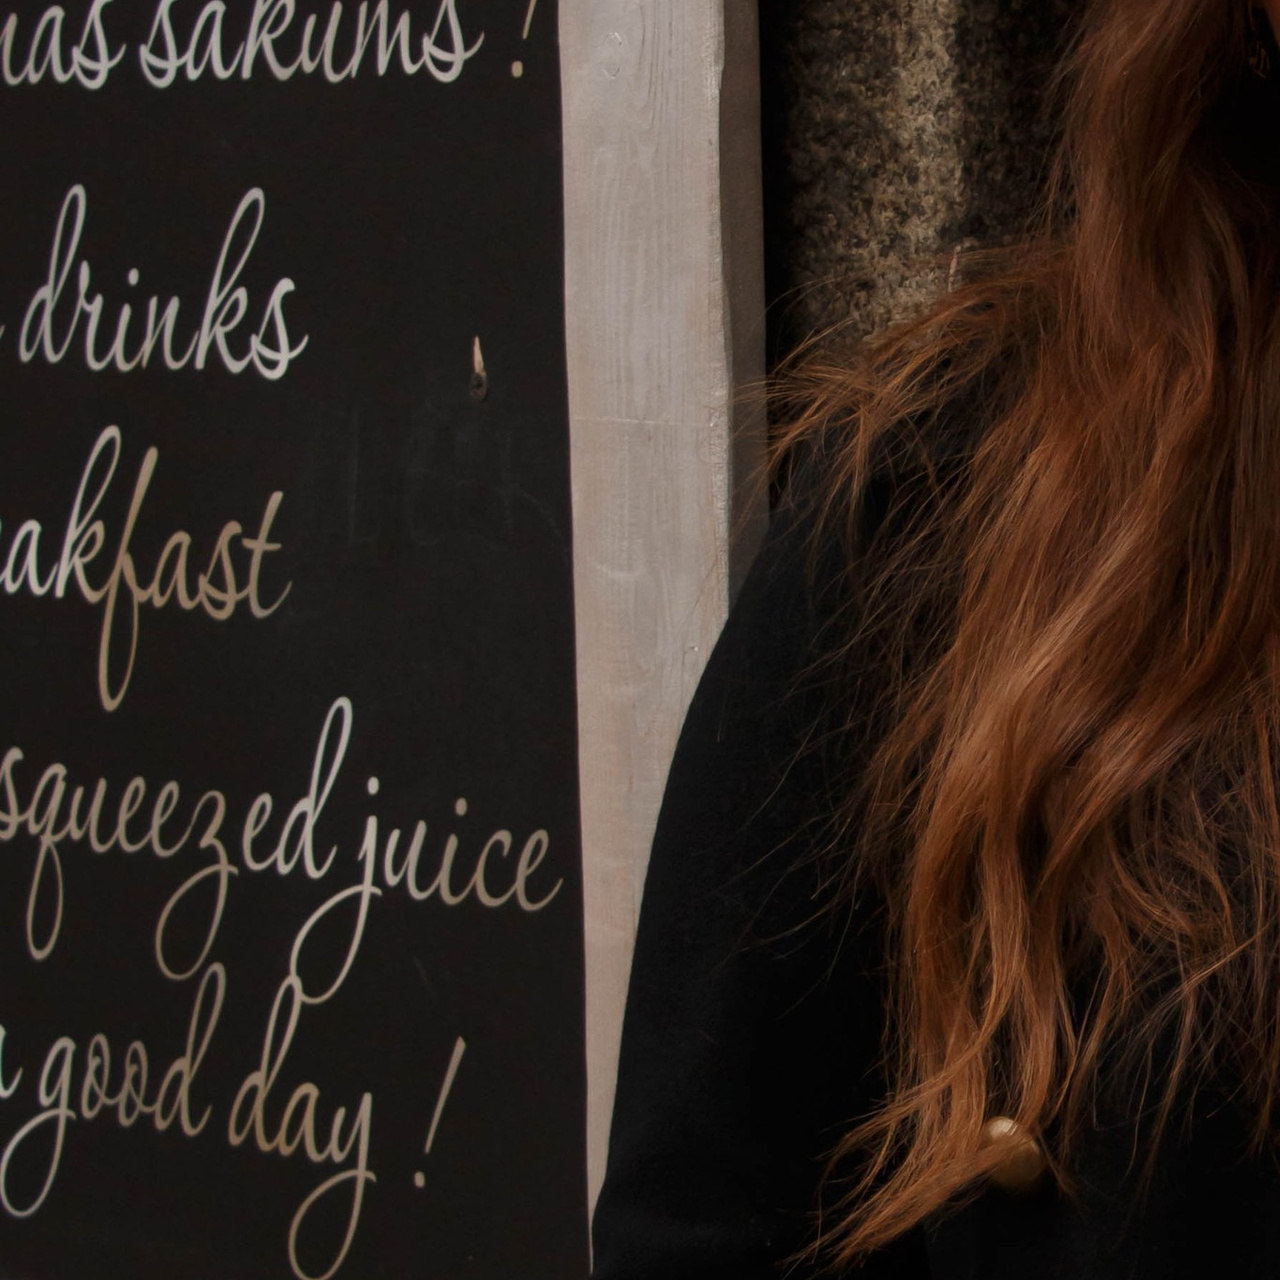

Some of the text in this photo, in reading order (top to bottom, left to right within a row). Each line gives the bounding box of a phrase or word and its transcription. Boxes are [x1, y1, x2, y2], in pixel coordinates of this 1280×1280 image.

[18, 184, 309, 381] drinks
[0, 696, 563, 1004] squeezed juice
[0, 962, 226, 1217] good
